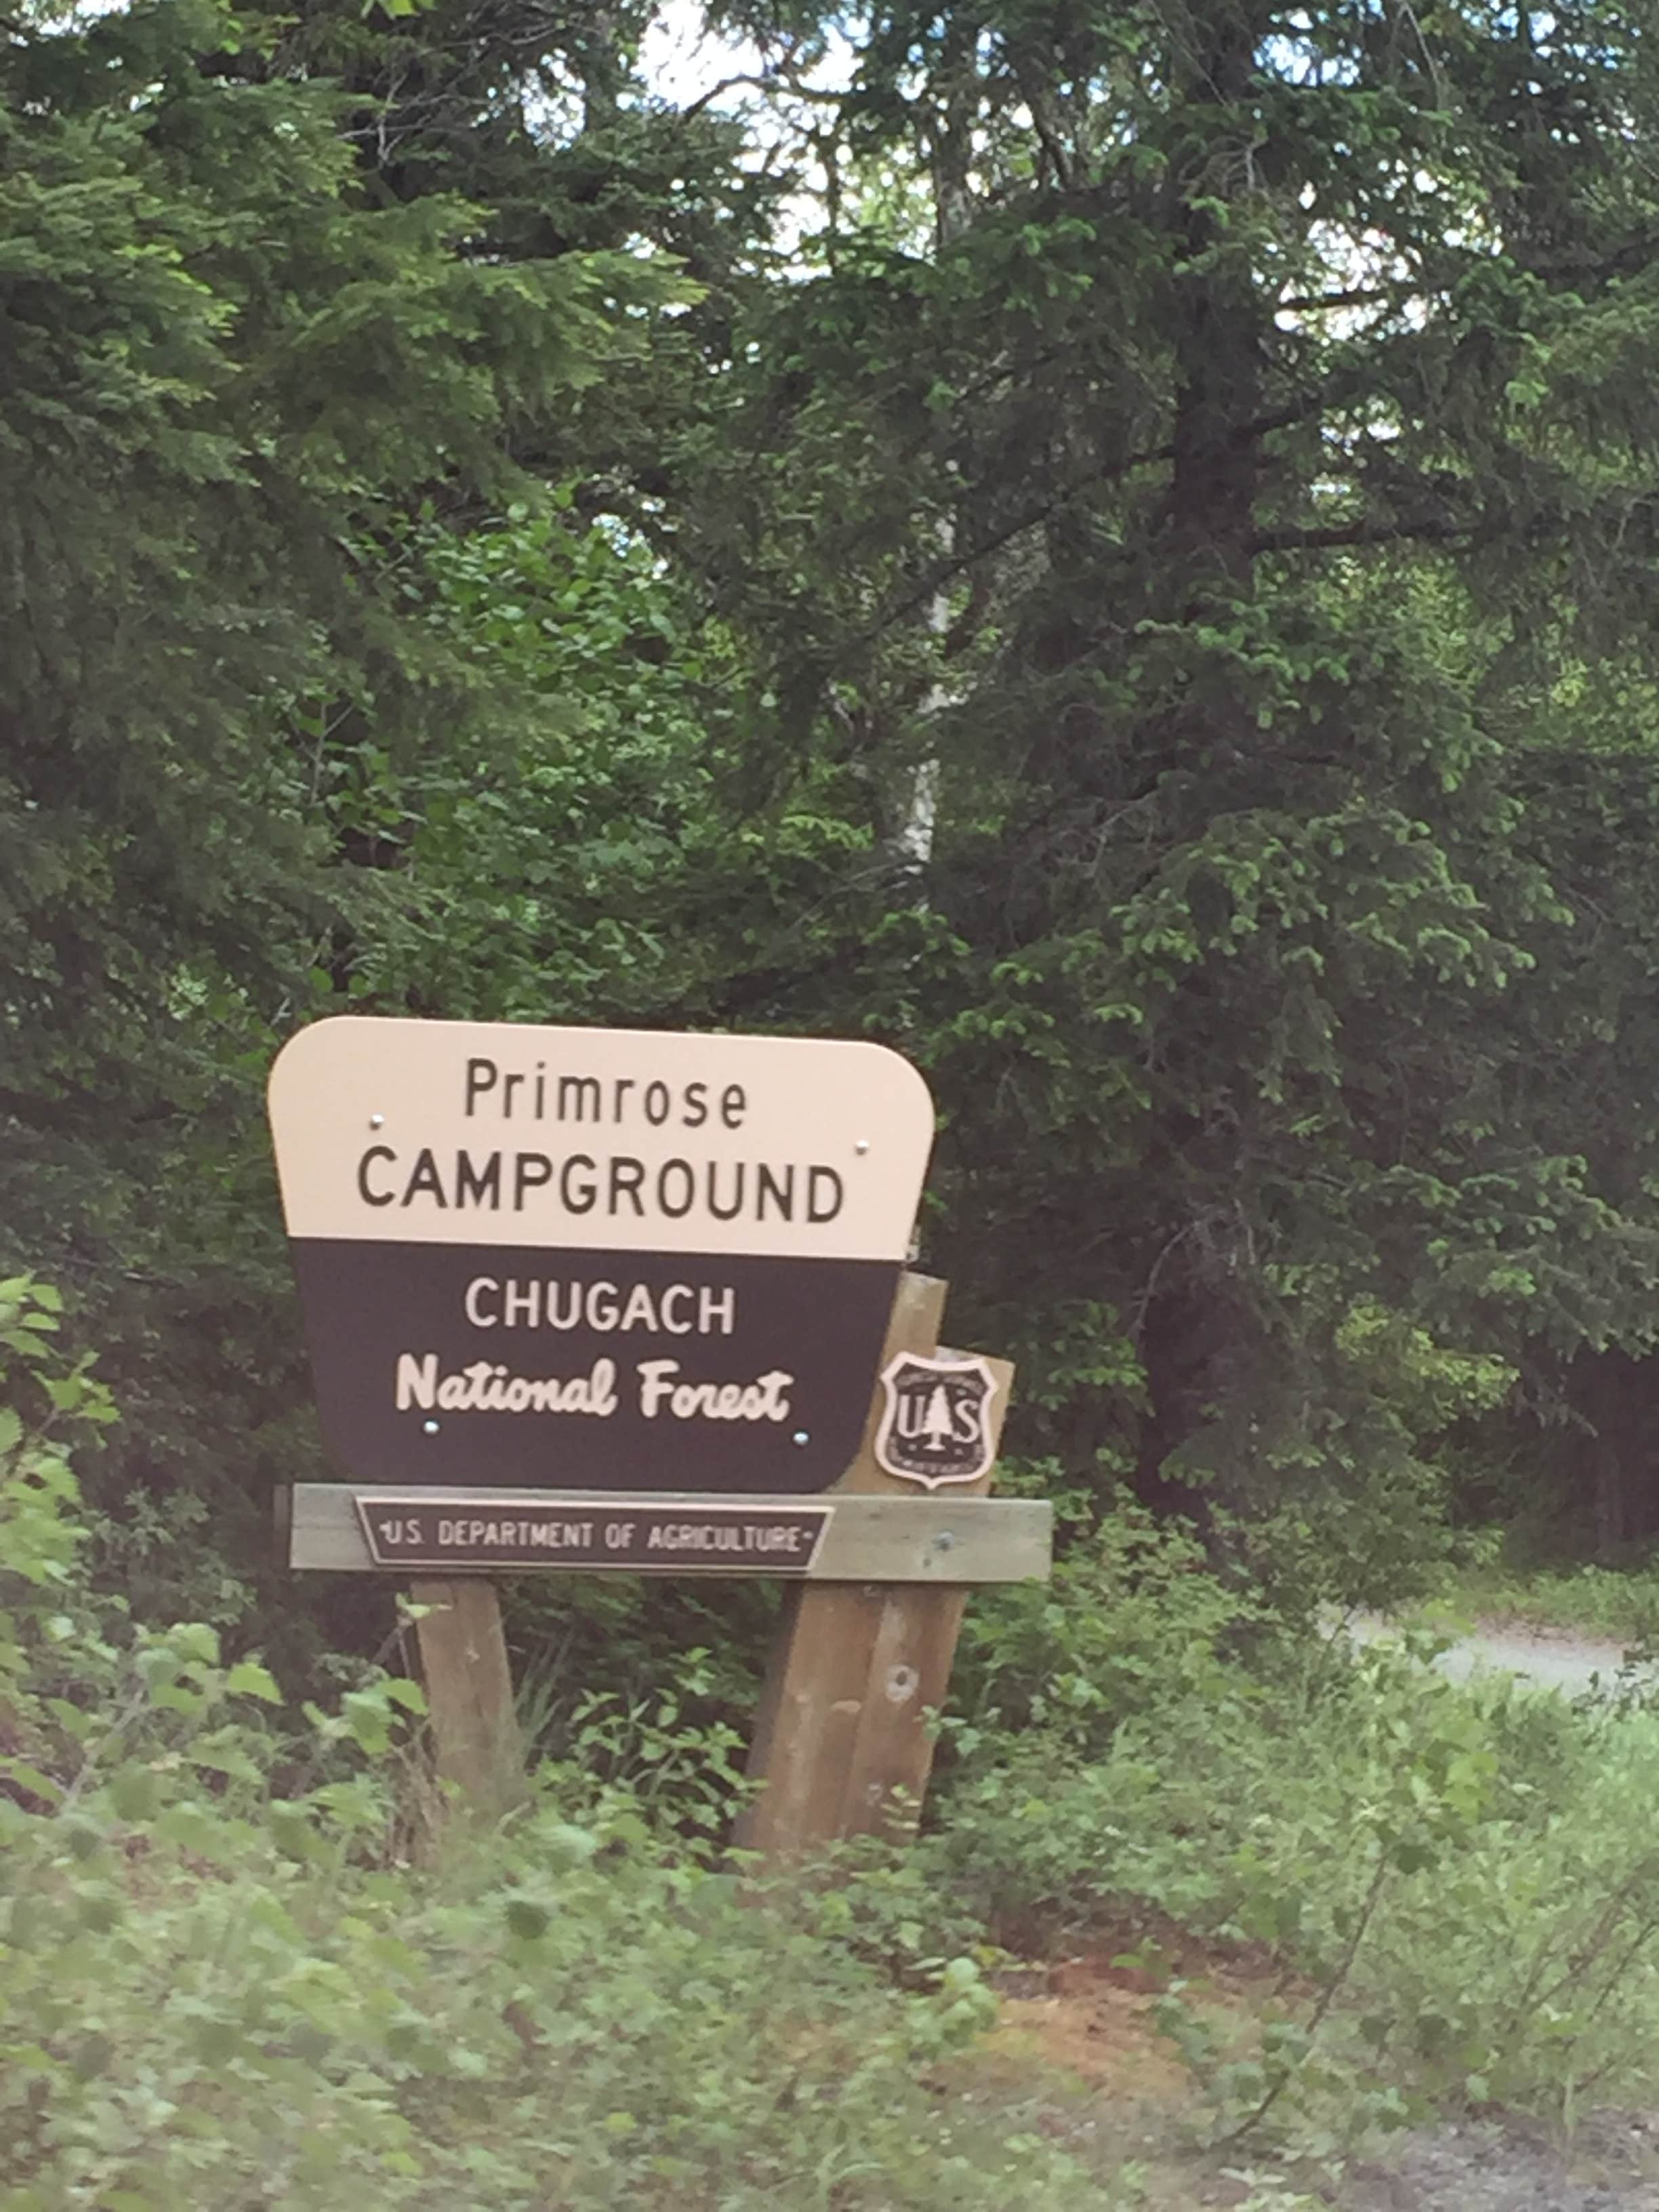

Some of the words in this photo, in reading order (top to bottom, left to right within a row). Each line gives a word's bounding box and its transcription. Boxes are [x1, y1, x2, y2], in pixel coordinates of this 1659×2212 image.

[465, 1058, 747, 1128] Primrose
[357, 1145, 842, 1223] CAMPGROUND
[465, 1277, 735, 1334] CHUGACH
[396, 1353, 617, 1416] National
[636, 1359, 794, 1421] Forest
[438, 1520, 594, 1548] DEPARTMENT
[605, 1523, 636, 1549] OF
[647, 1523, 801, 1552] AGRICULTURE
